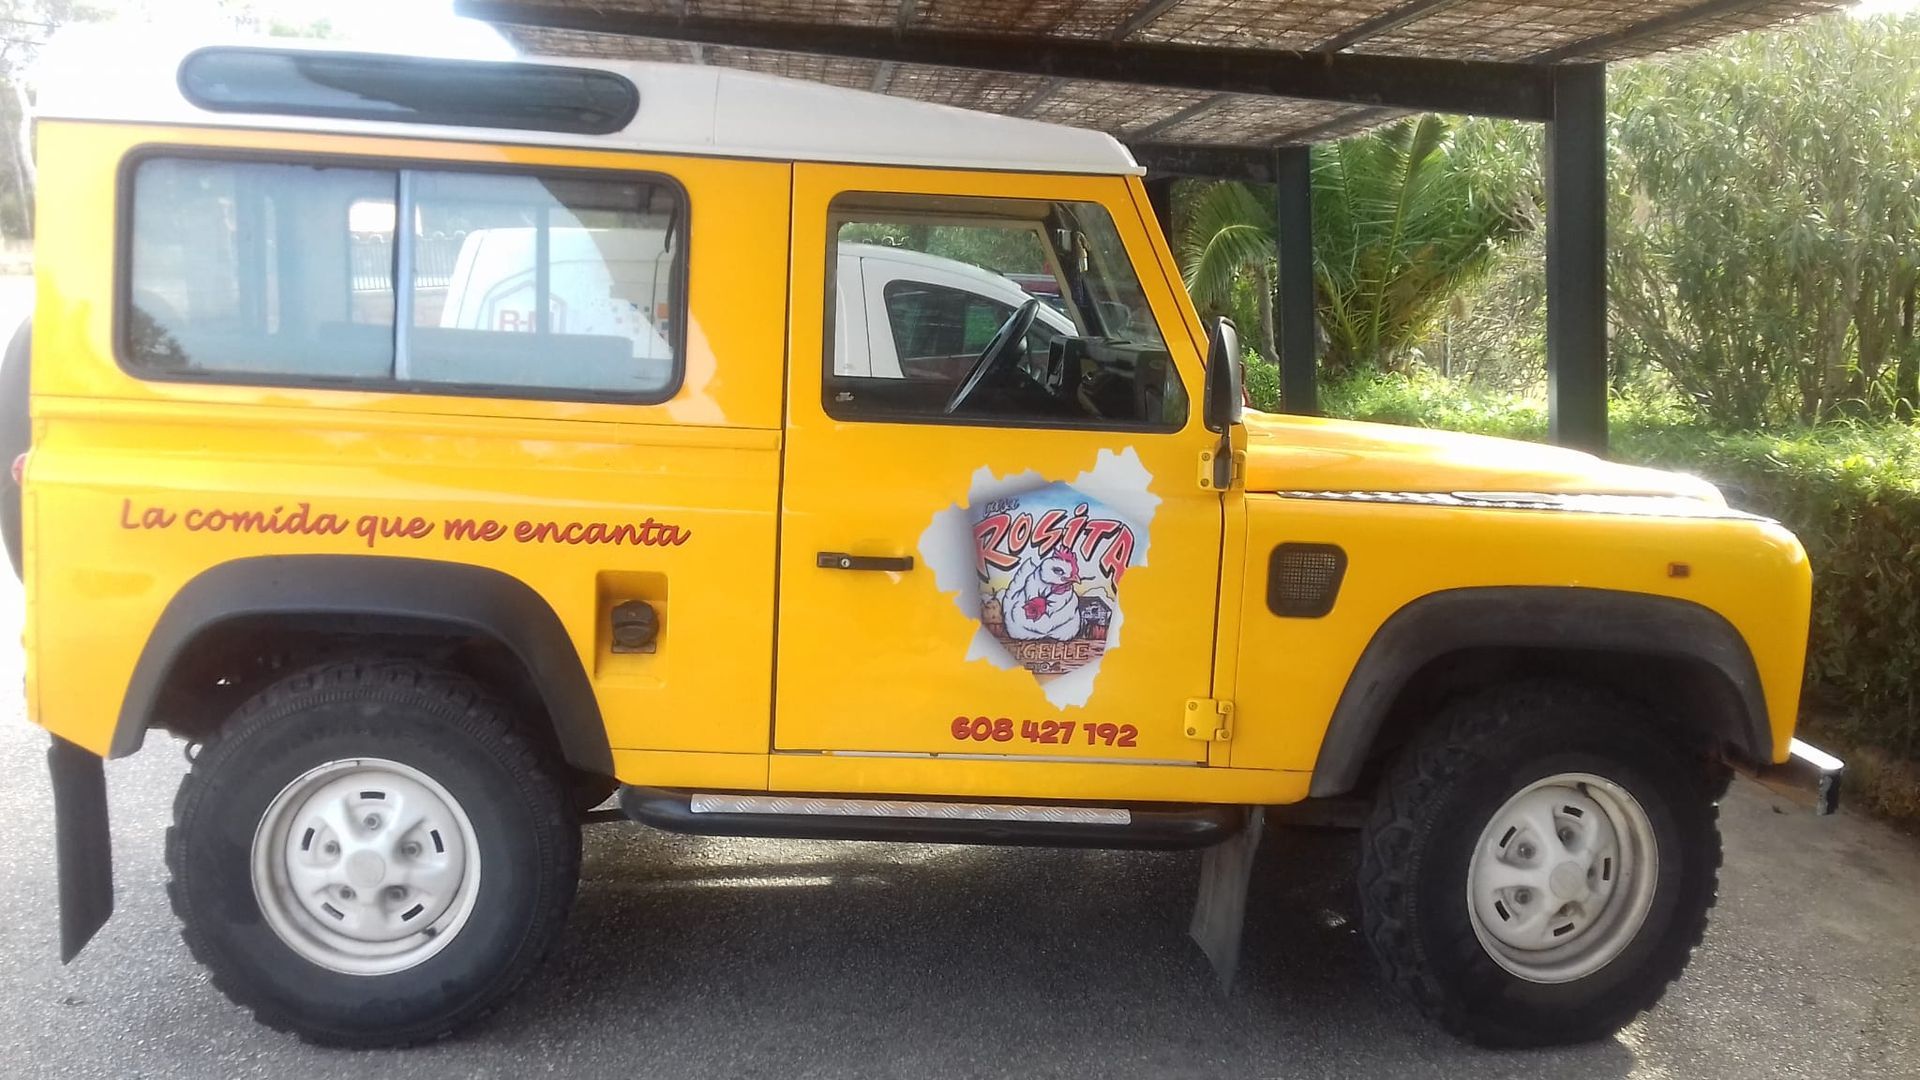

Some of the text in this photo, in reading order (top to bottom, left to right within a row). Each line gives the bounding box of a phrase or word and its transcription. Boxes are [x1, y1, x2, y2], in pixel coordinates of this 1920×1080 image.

[120, 498, 176, 530] La
[356, 512, 435, 548] que
[444, 517, 508, 542] me
[513, 518, 692, 547] encanta
[950, 716, 1139, 748] 608 427 192
